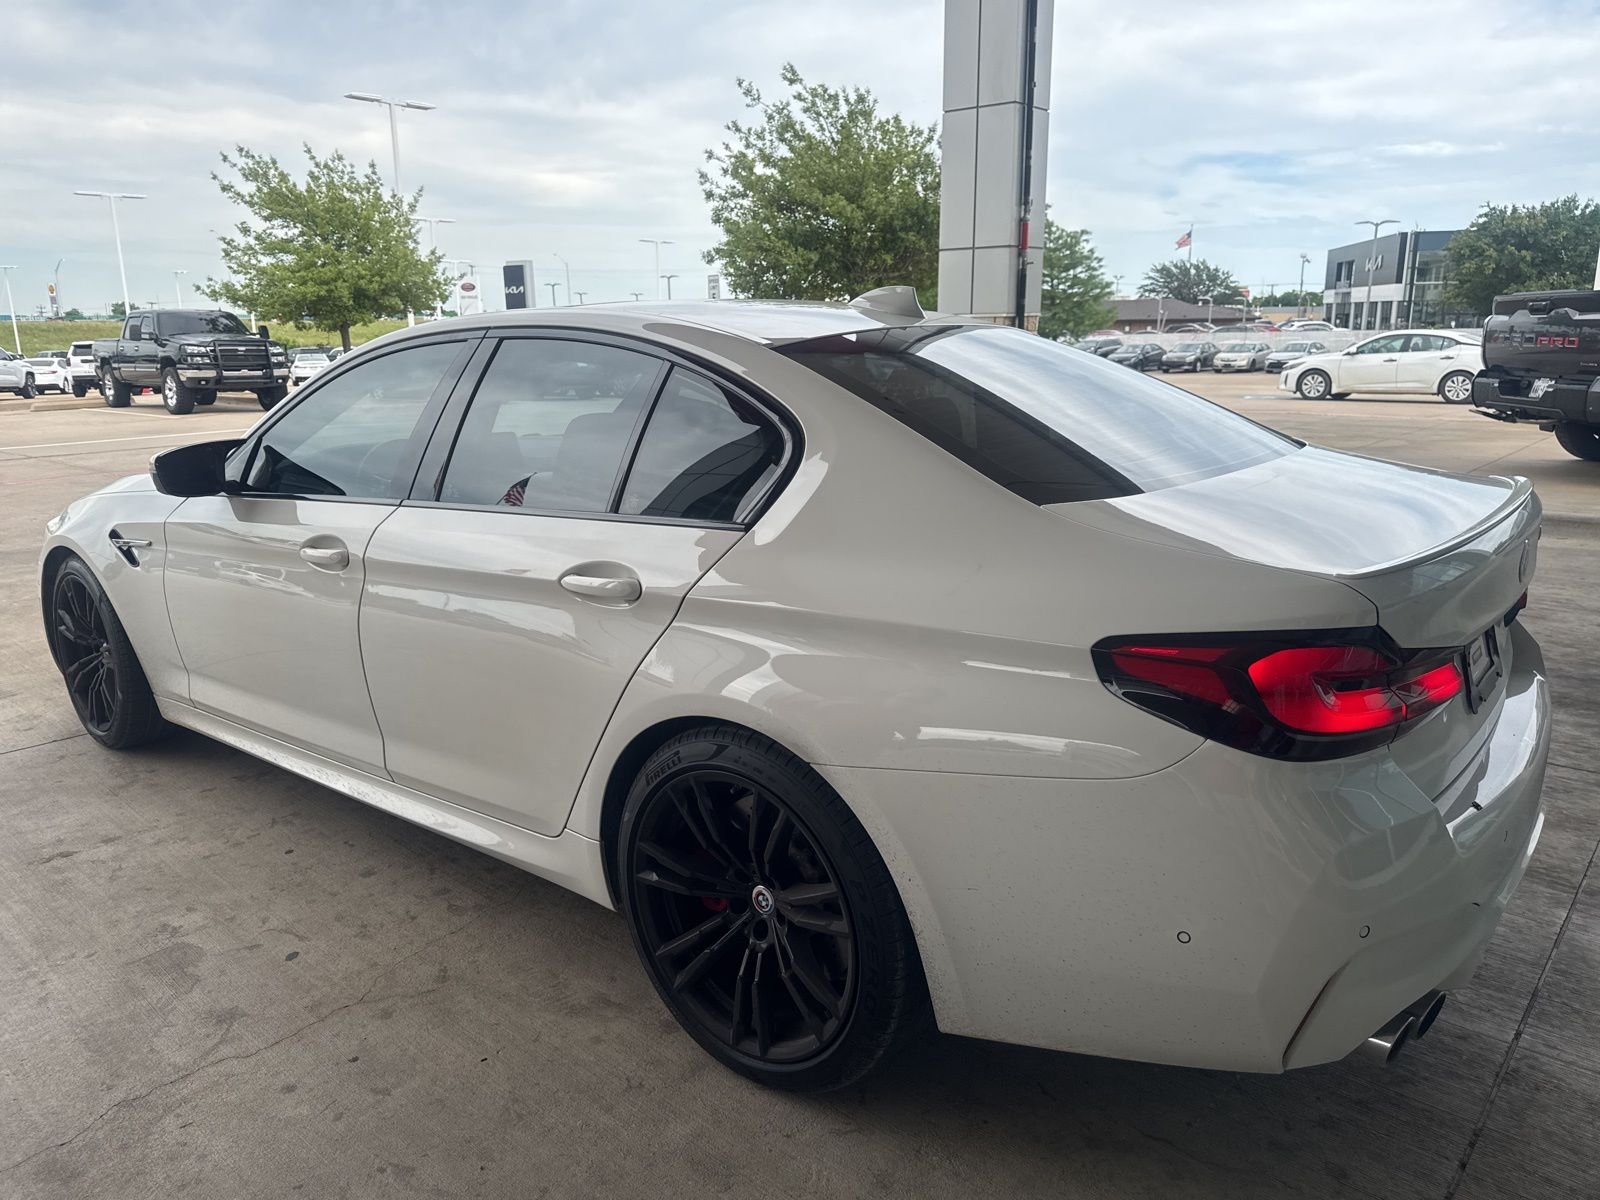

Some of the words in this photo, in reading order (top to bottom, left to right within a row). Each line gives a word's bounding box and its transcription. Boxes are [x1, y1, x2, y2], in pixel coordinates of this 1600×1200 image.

[505, 285, 524, 294] KIA
[1536, 336, 1580, 348] PRO
[645, 750, 682, 787] PIRELLI
